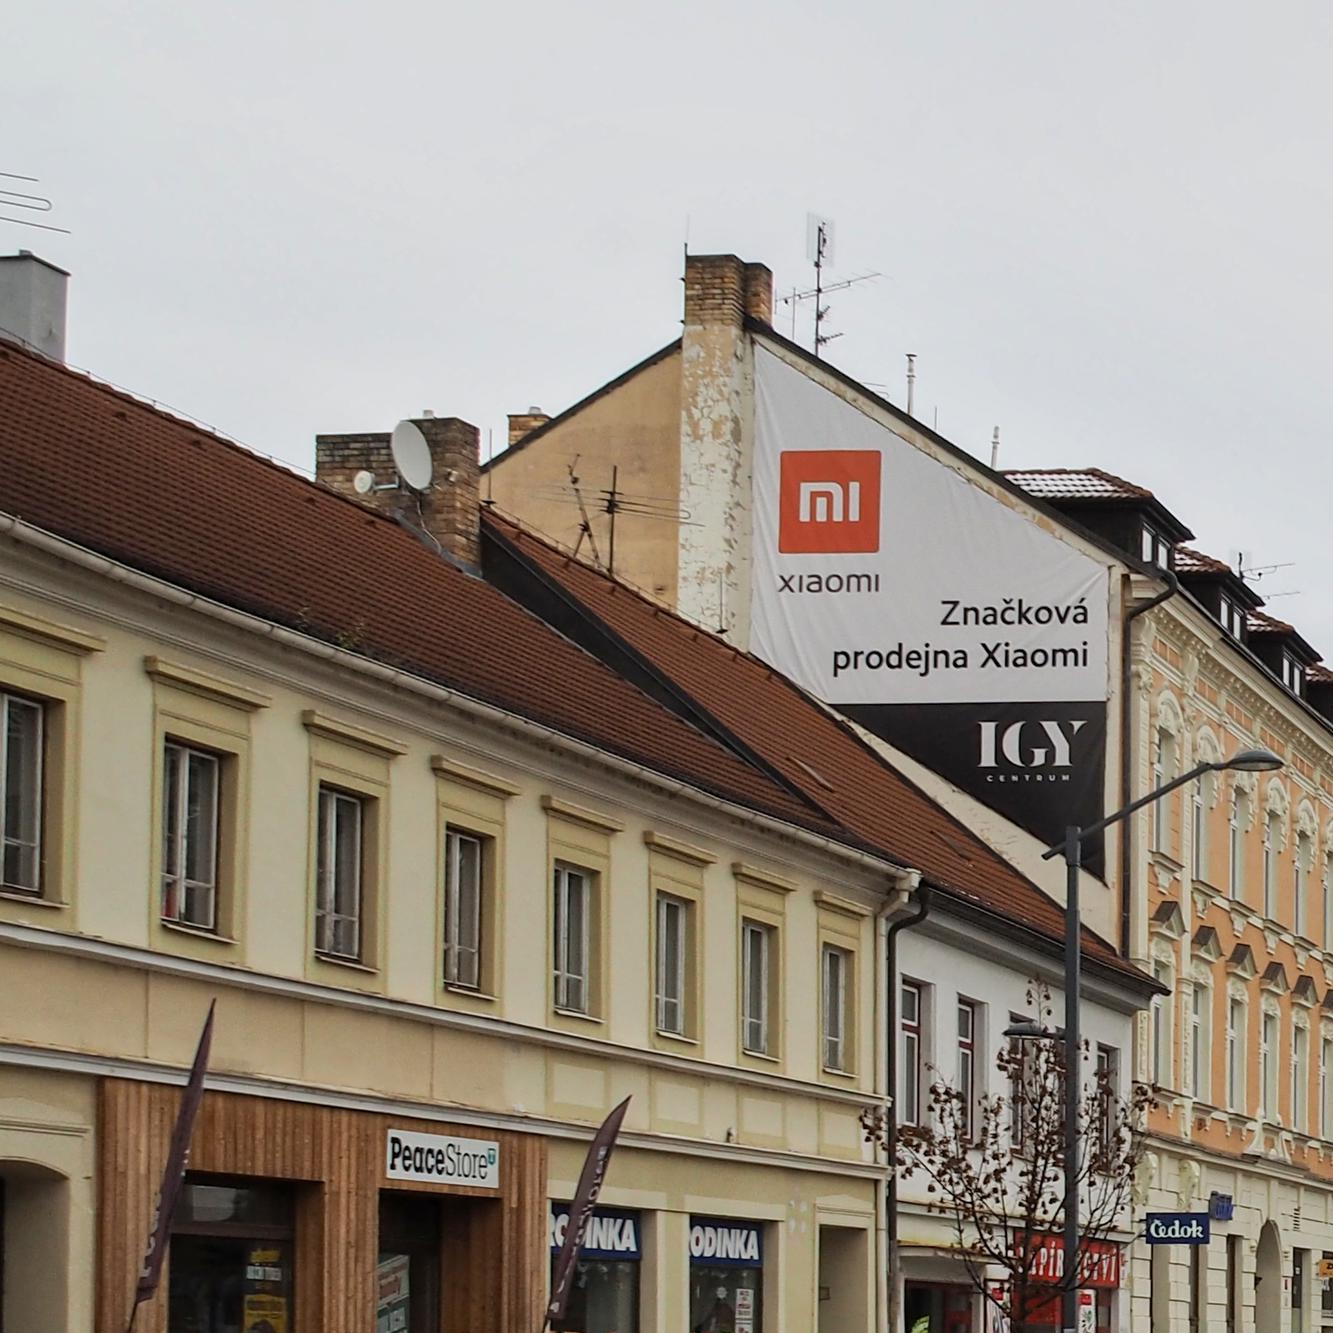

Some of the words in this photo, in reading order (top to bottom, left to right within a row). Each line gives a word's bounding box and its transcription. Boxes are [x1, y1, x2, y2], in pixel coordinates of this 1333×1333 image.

[778, 574, 879, 593] xiaomi
[940, 597, 1088, 625] Značková
[833, 643, 968, 677] prodejna
[980, 641, 1088, 668] Xiaomi
[977, 720, 1088, 768] IGY
[986, 774, 1070, 783] CENTRUM
[390, 1136, 488, 1180] PeaceStore
[690, 1225, 760, 1260] ODINKA
[1150, 1219, 1204, 1239] Čedok
